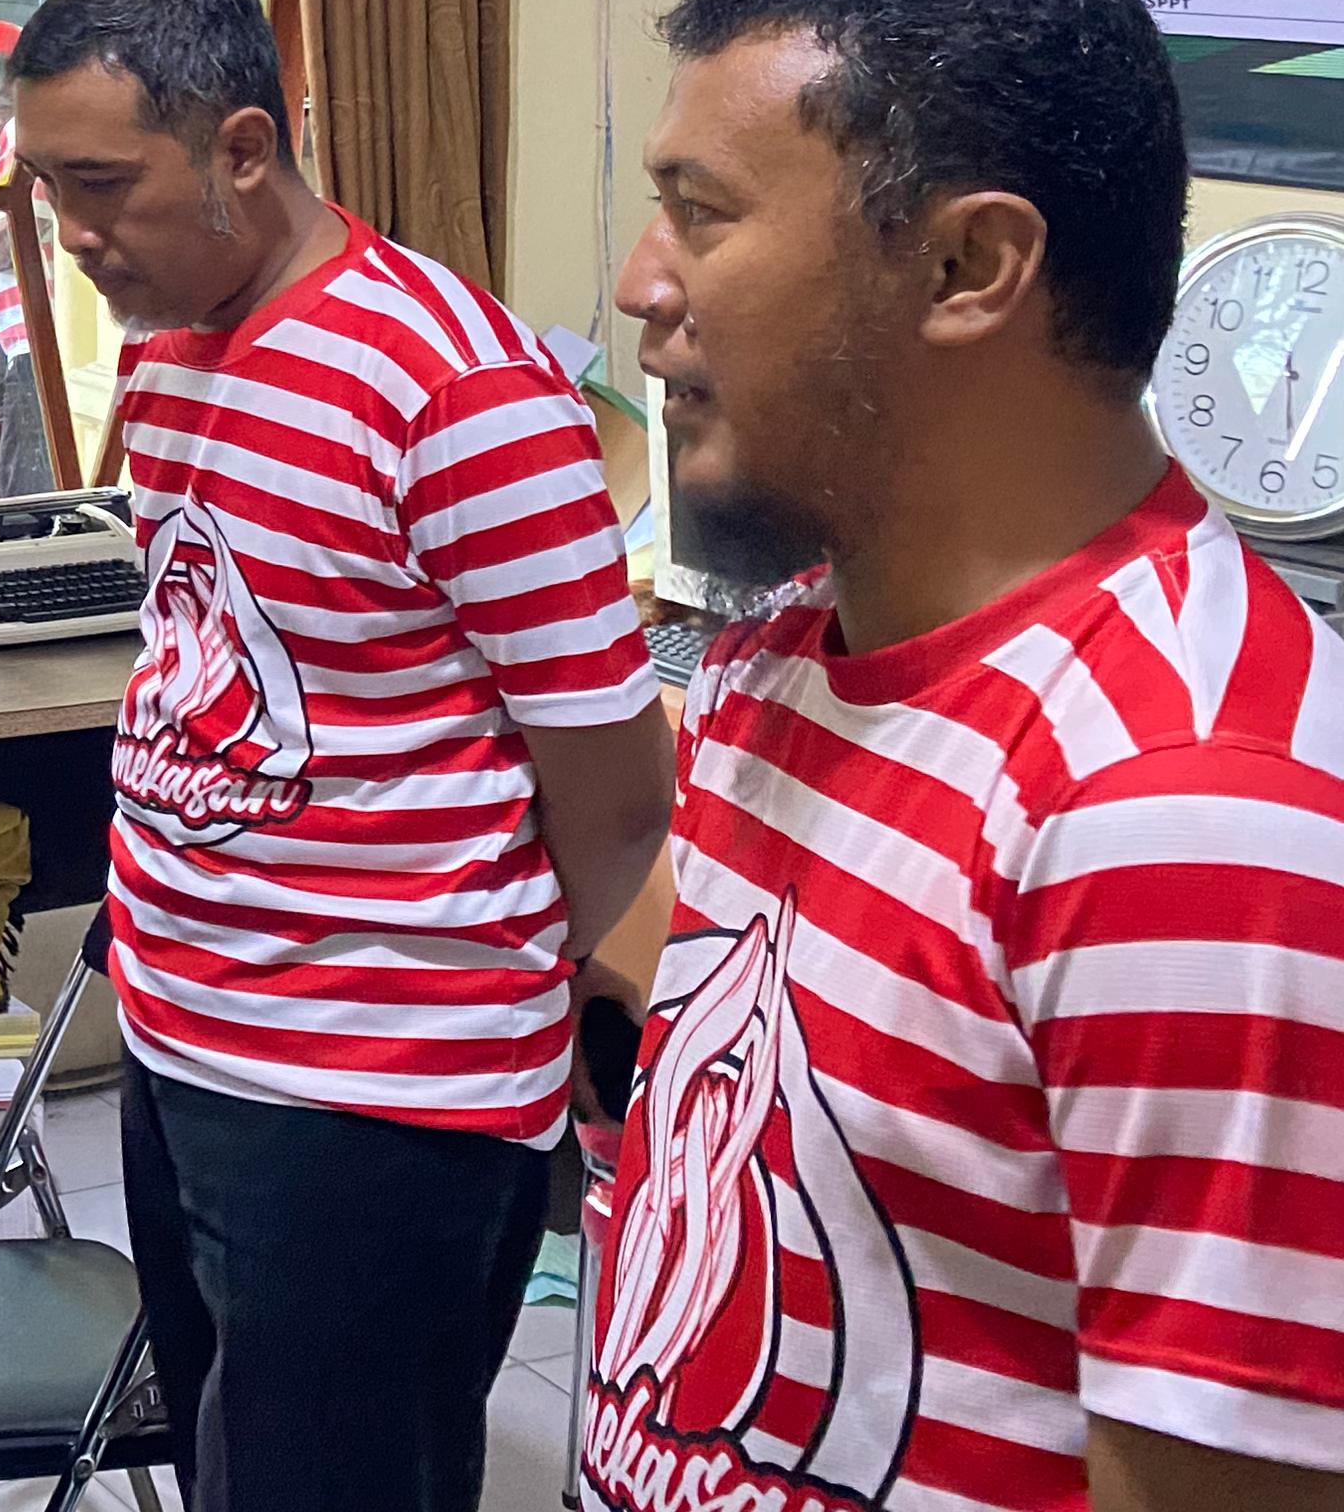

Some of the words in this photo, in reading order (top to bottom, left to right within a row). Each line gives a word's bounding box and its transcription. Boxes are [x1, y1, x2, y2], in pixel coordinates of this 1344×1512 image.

[1294, 259, 1330, 295] 12
[1209, 299, 1244, 331] 10
[1184, 343, 1210, 375] 9
[1189, 395, 1215, 427] 8
[1221, 435, 1243, 470] 7
[1260, 460, 1287, 493] 6
[1312, 453, 1339, 489] 5
[112, 736, 300, 819] mekasan
